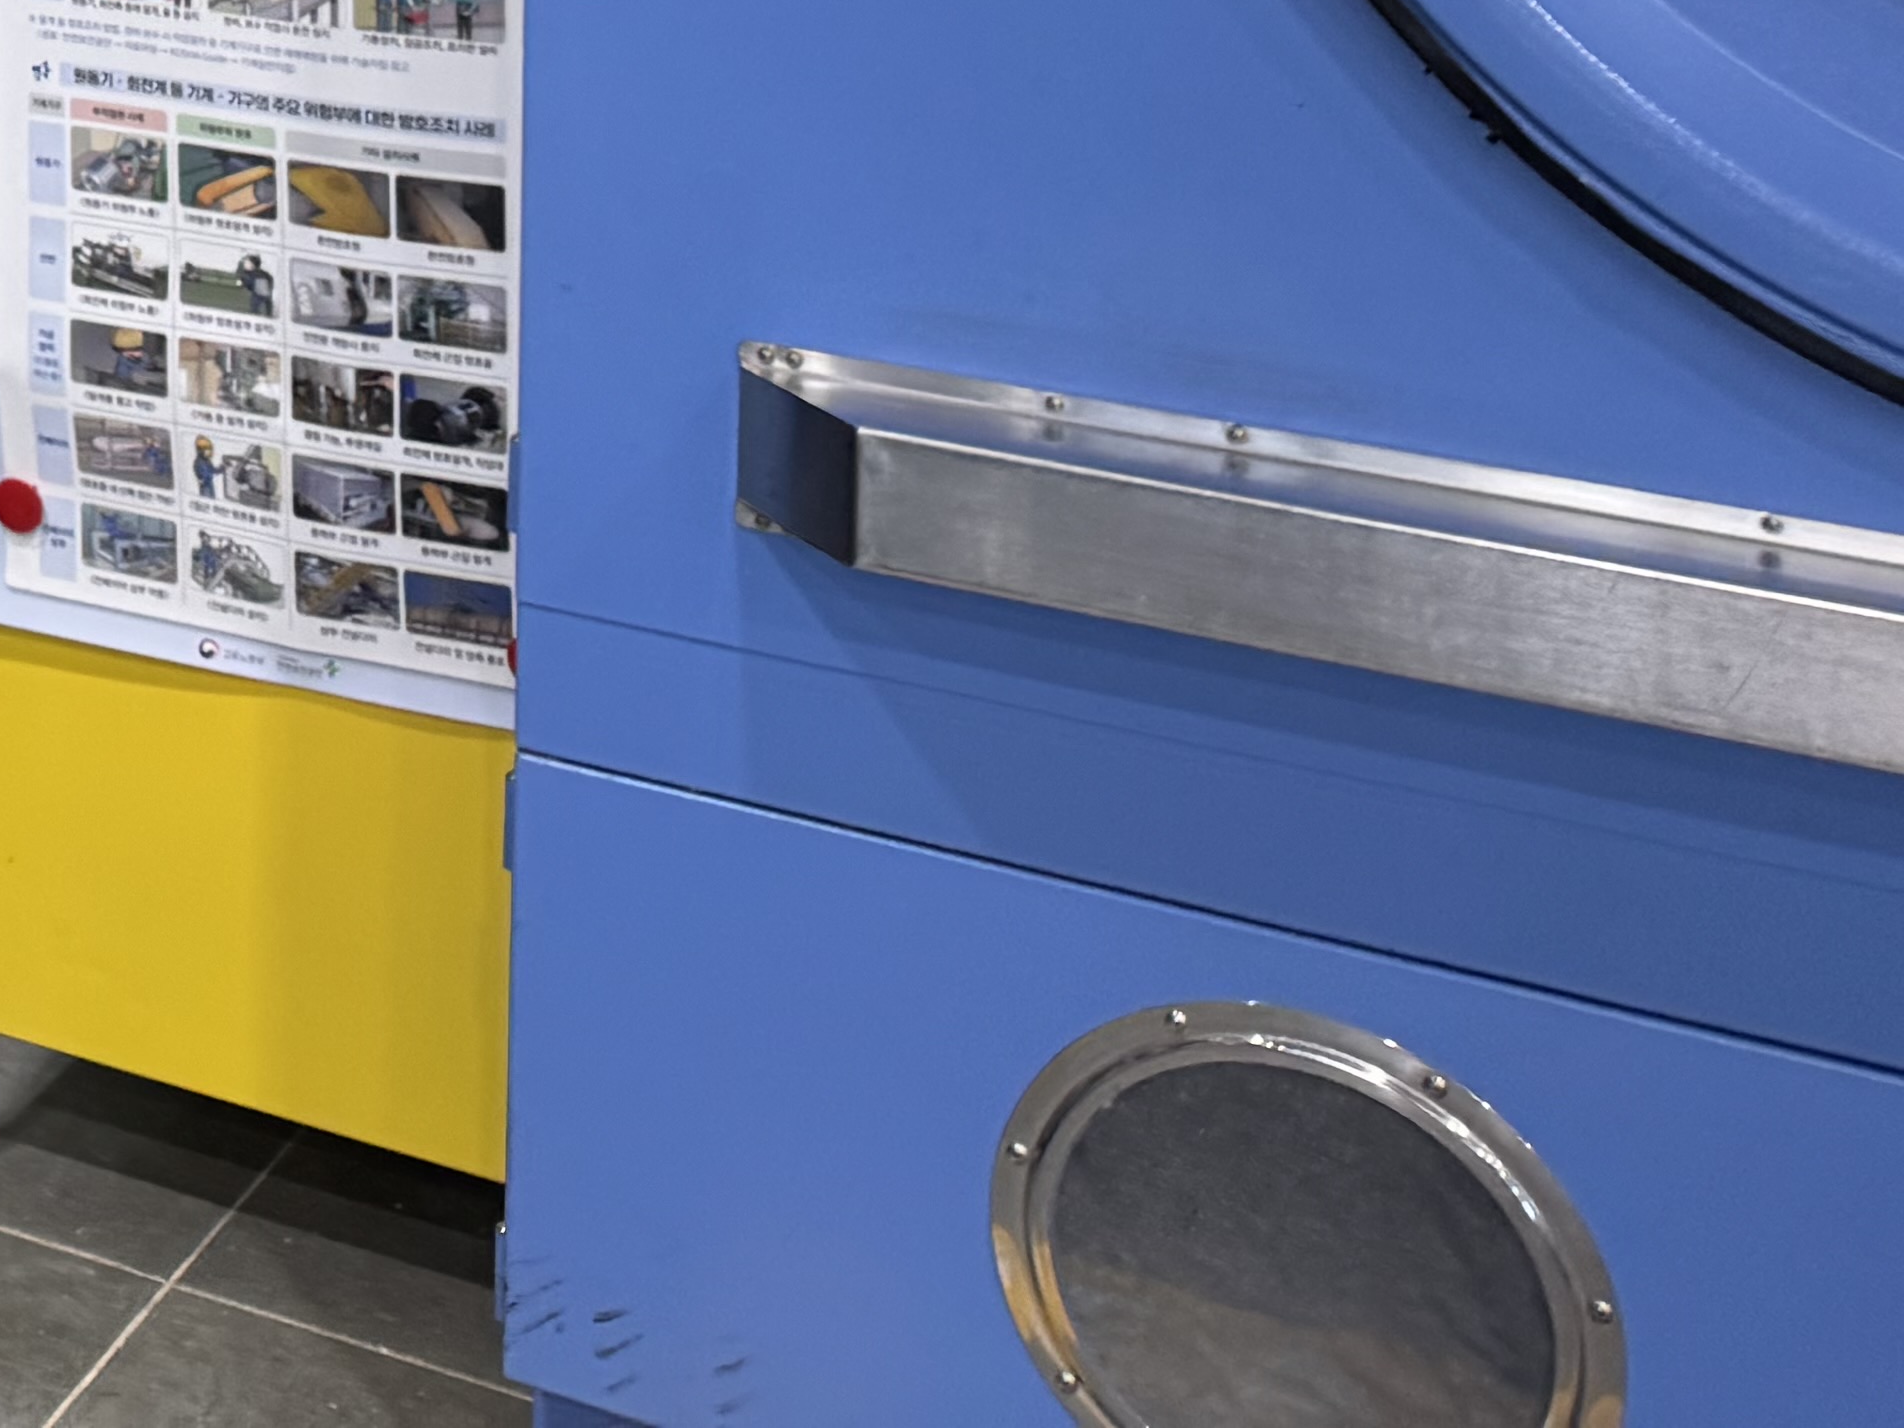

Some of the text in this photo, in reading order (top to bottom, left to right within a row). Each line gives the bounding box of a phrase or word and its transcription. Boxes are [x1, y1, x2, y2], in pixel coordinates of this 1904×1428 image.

[187, 83, 215, 104] 기계
[227, 89, 271, 111] 기구의
[273, 95, 302, 117] 주요
[364, 108, 395, 129] 대한
